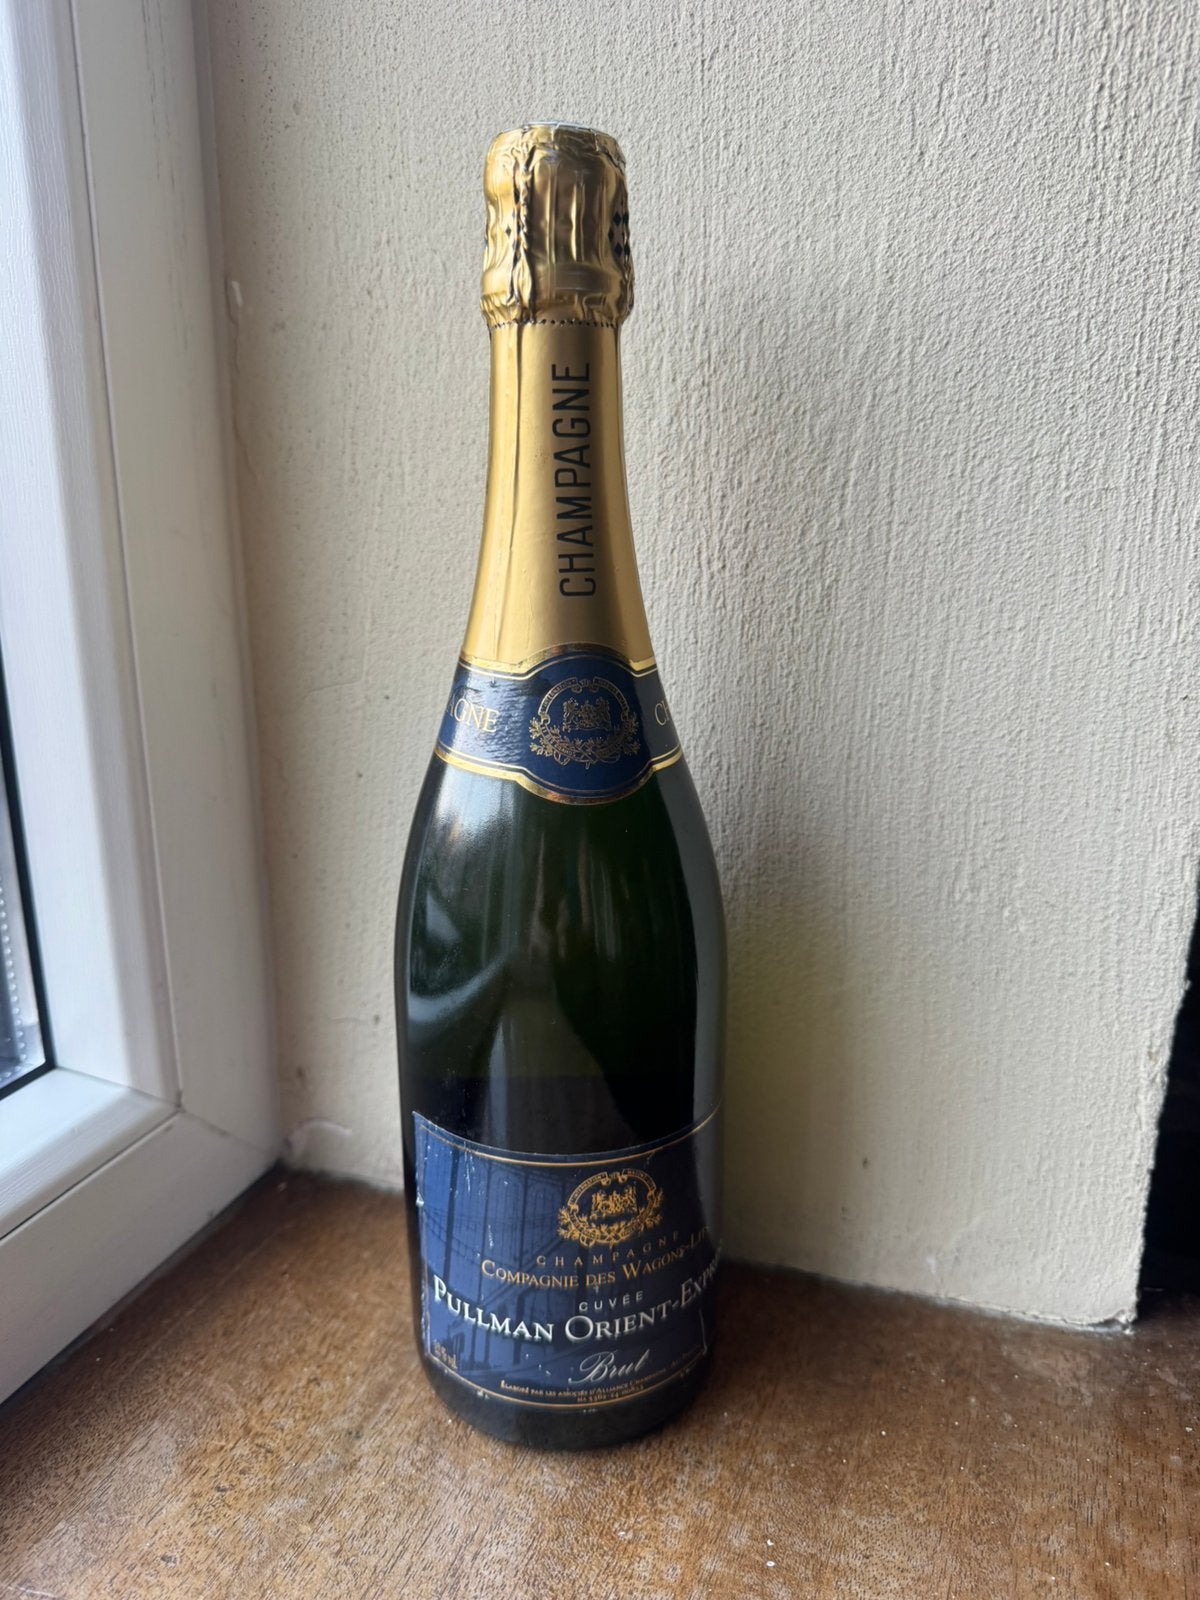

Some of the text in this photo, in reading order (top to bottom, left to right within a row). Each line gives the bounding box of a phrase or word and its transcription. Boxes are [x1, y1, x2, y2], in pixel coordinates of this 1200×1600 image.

[551, 362, 597, 597] CHAMPAGNE
[535, 1230, 679, 1267] CHAMPAGNE
[481, 1259, 579, 1288] COMPAGNIE
[585, 1271, 616, 1287] DES
[433, 1274, 555, 1342] PULLMAN
[578, 1290, 644, 1313] CUVÉE
[567, 1348, 650, 1385] Brut
